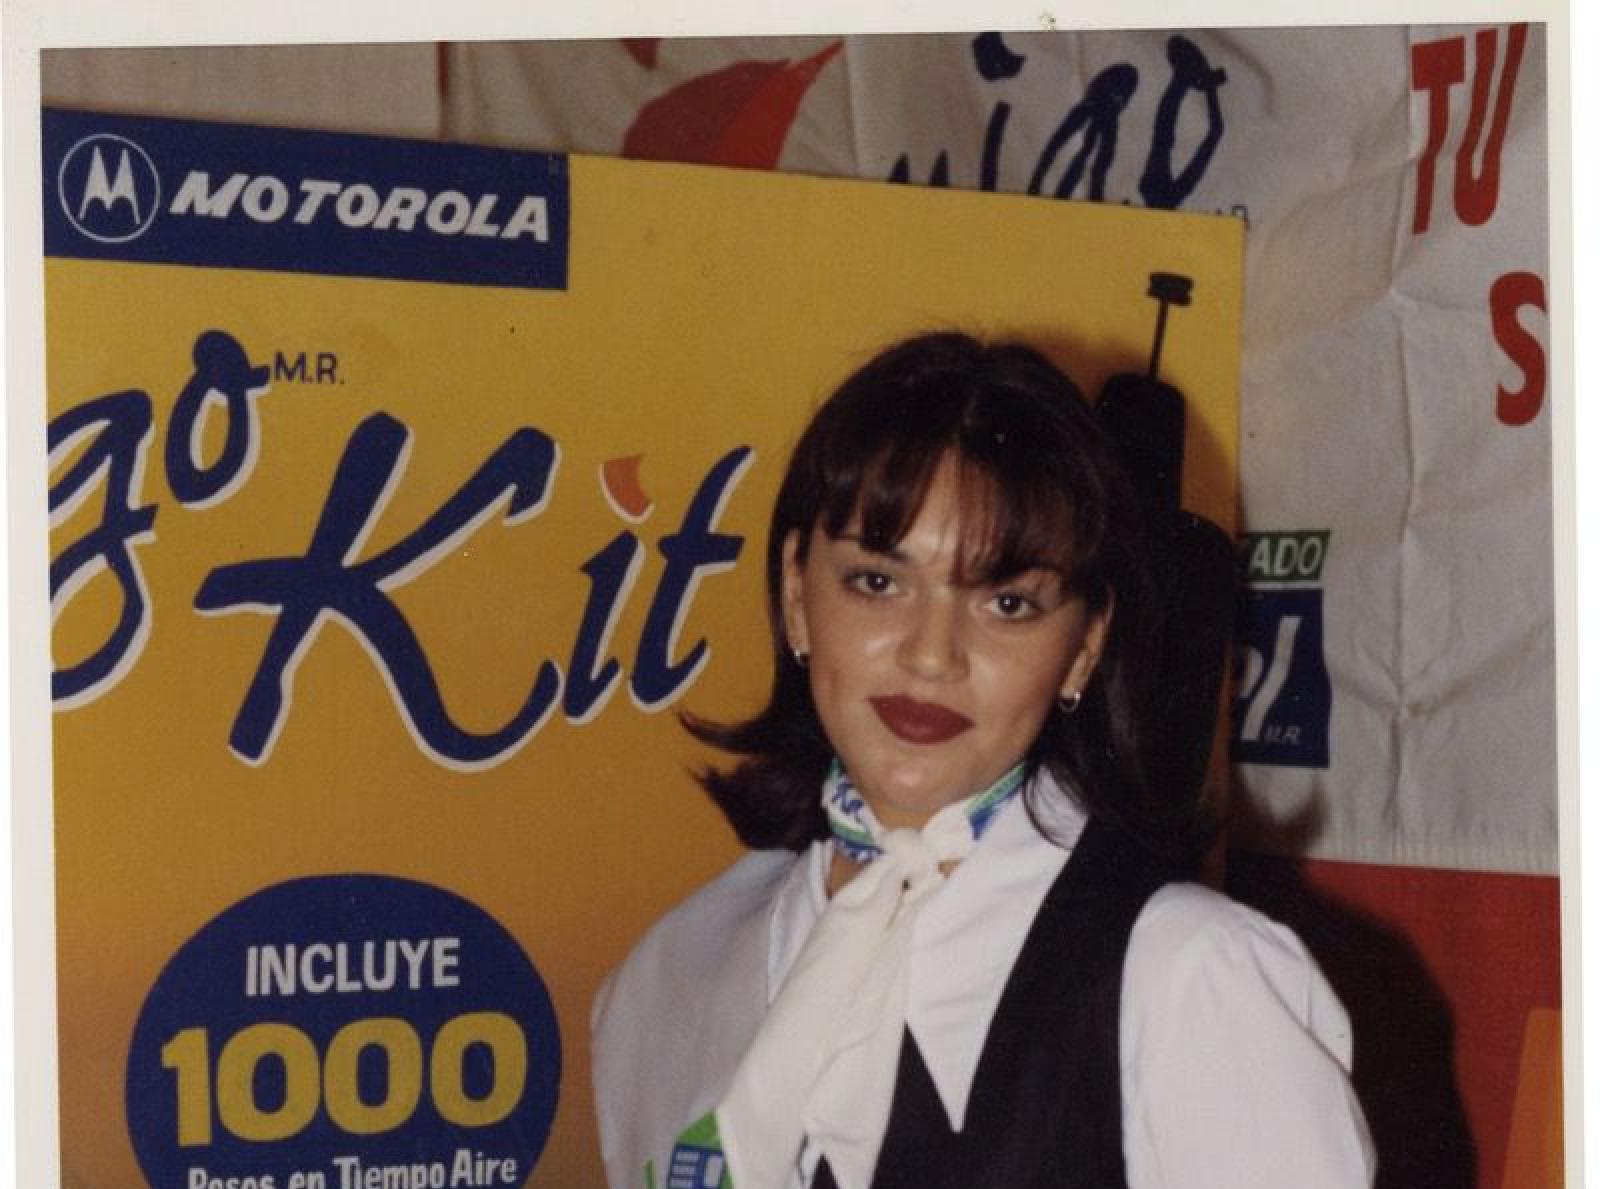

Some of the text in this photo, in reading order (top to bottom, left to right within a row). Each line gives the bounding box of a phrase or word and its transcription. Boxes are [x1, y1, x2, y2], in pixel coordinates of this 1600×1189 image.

[1411, 22, 1528, 236] TU
[170, 171, 550, 243] MOTOROLA
[273, 351, 346, 386] M.R.
[193, 410, 756, 772] Kit
[245, 937, 461, 997] INCLUYE
[160, 1010, 528, 1148] 1000
[450, 1147, 518, 1188] Aire
